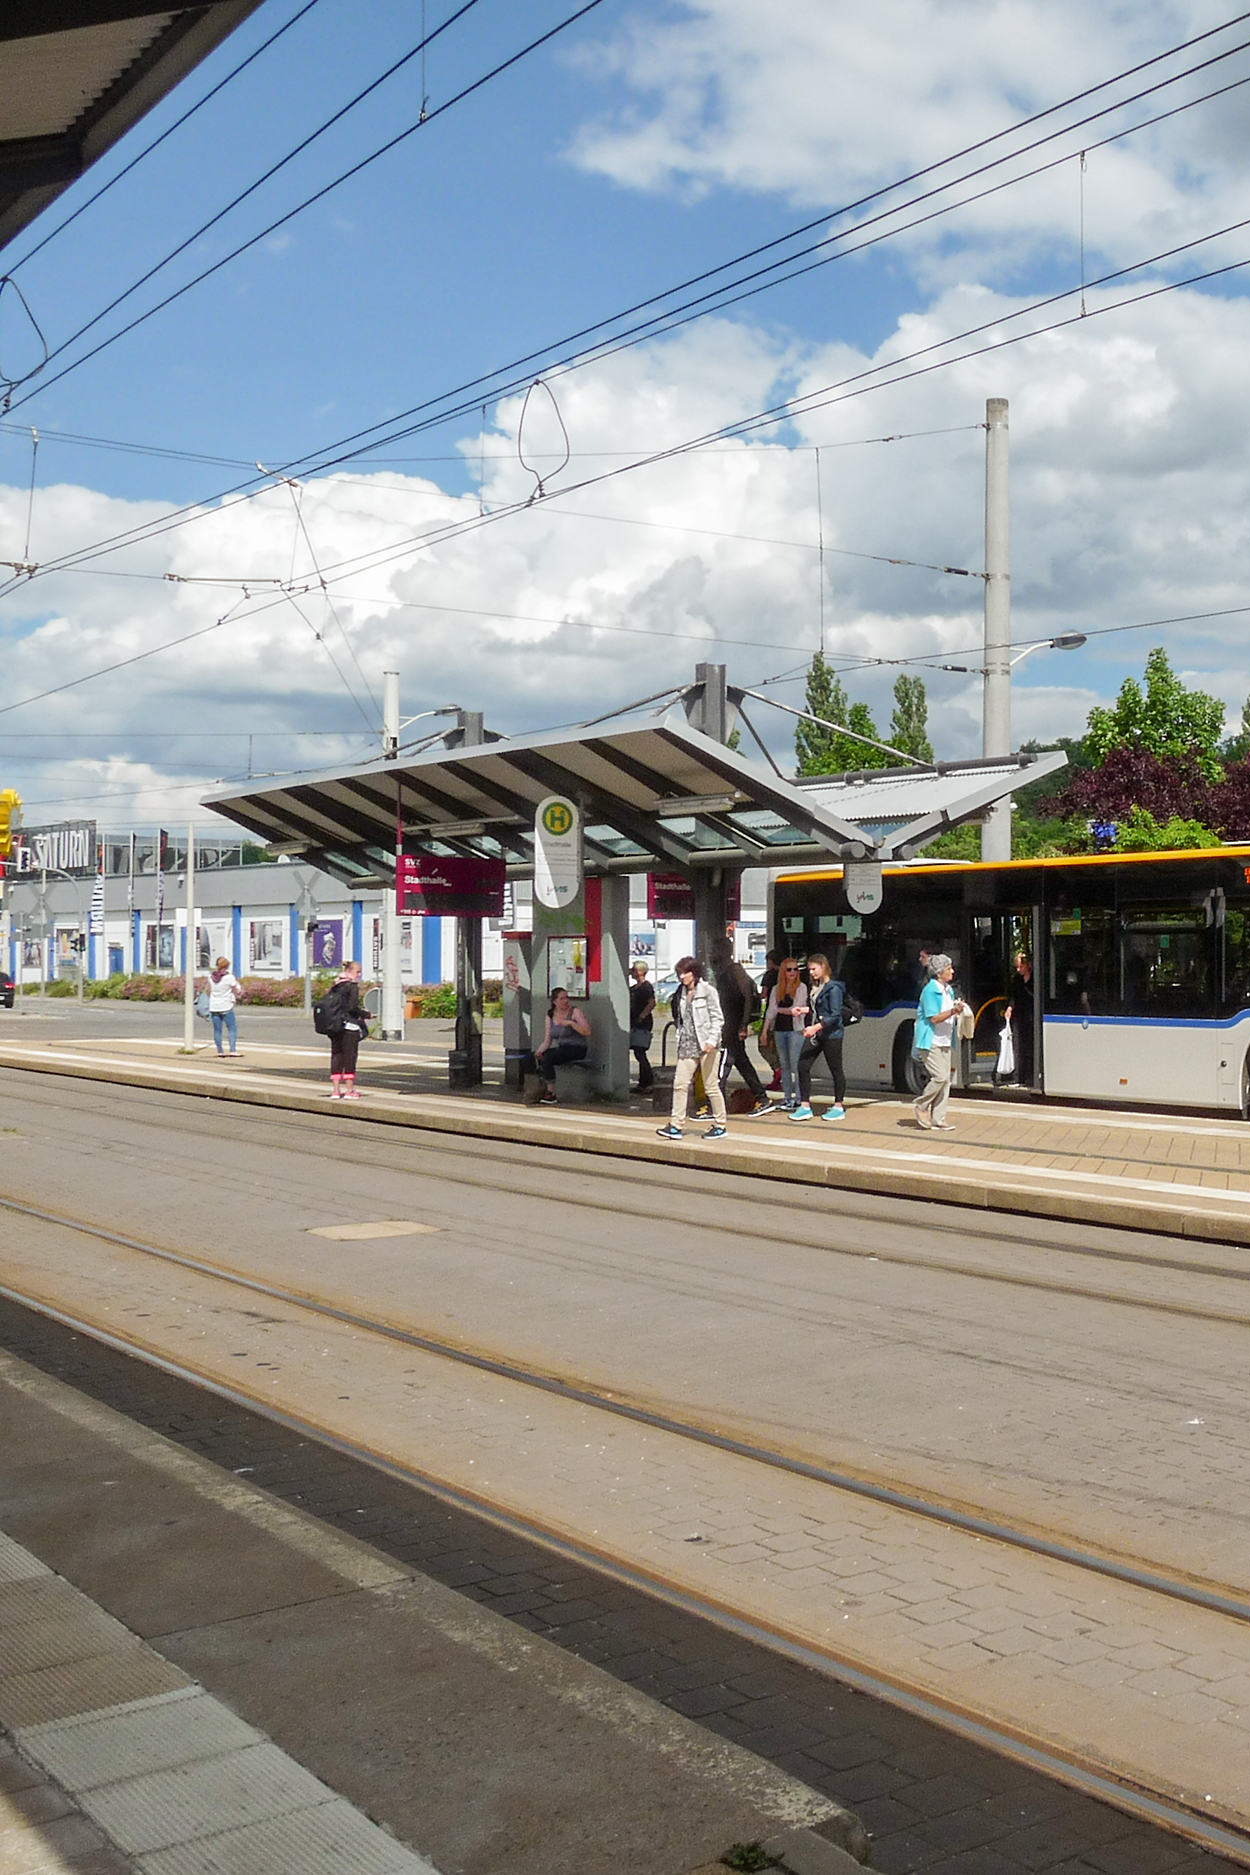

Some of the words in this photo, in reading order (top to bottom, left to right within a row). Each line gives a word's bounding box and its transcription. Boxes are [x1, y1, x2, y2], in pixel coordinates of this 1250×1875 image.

[550, 810, 565, 828] H
[32, 830, 89, 869] SATURN
[404, 858, 421, 866] SVZ
[404, 875, 447, 885] Stadthalle
[654, 882, 691, 891] Stadthalle
